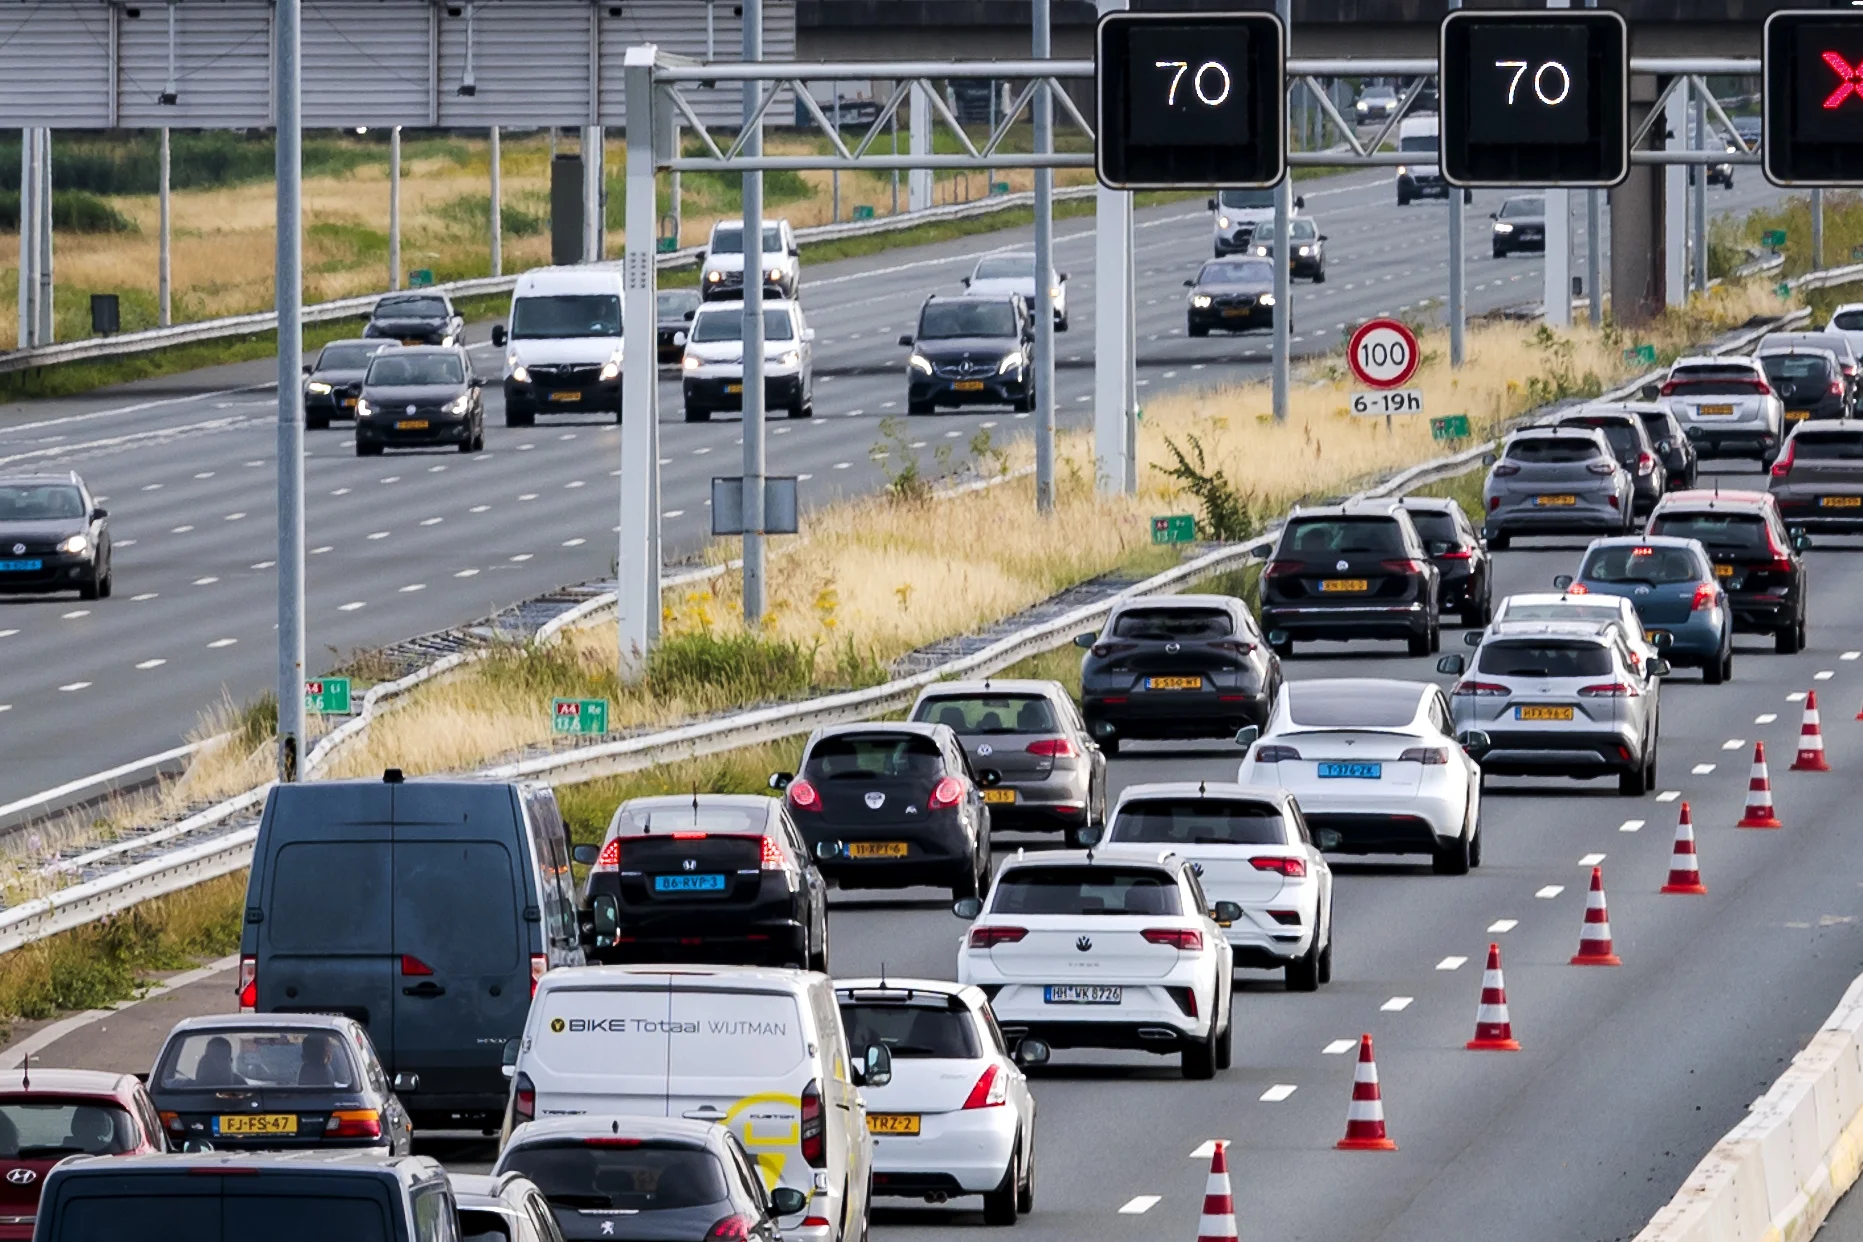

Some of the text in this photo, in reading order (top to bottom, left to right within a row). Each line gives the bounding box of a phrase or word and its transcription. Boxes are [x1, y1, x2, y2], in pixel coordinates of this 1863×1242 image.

[1155, 61, 1231, 106] 70
[1495, 61, 1570, 106] 70
[1361, 341, 1406, 368] 100
[1354, 392, 1421, 413] 6-19h
[568, 1018, 787, 1037] BIKE Totaal WIJTMAN
[227, 1117, 290, 1131] FJ-FS-47
